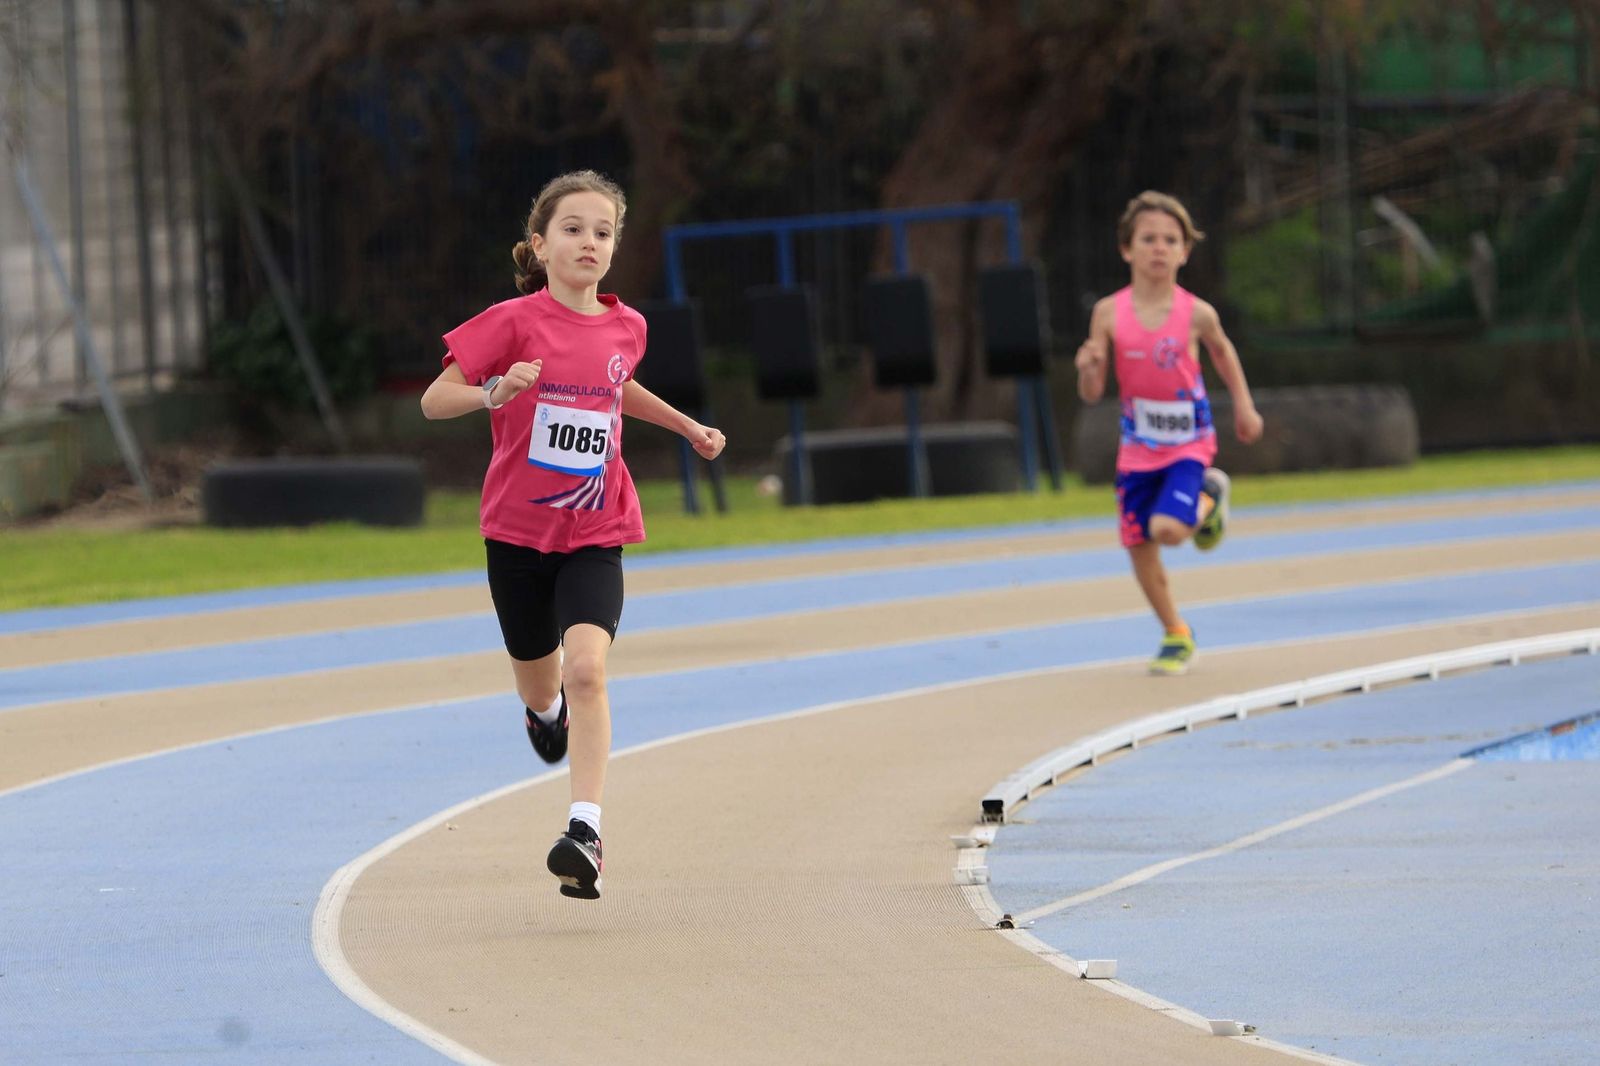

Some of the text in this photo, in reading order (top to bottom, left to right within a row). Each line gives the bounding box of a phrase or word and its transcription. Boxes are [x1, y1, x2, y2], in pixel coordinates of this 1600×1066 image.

[538, 391, 576, 403] atletismo
[539, 382, 612, 397] INMACULADA
[547, 422, 607, 455] 1085
